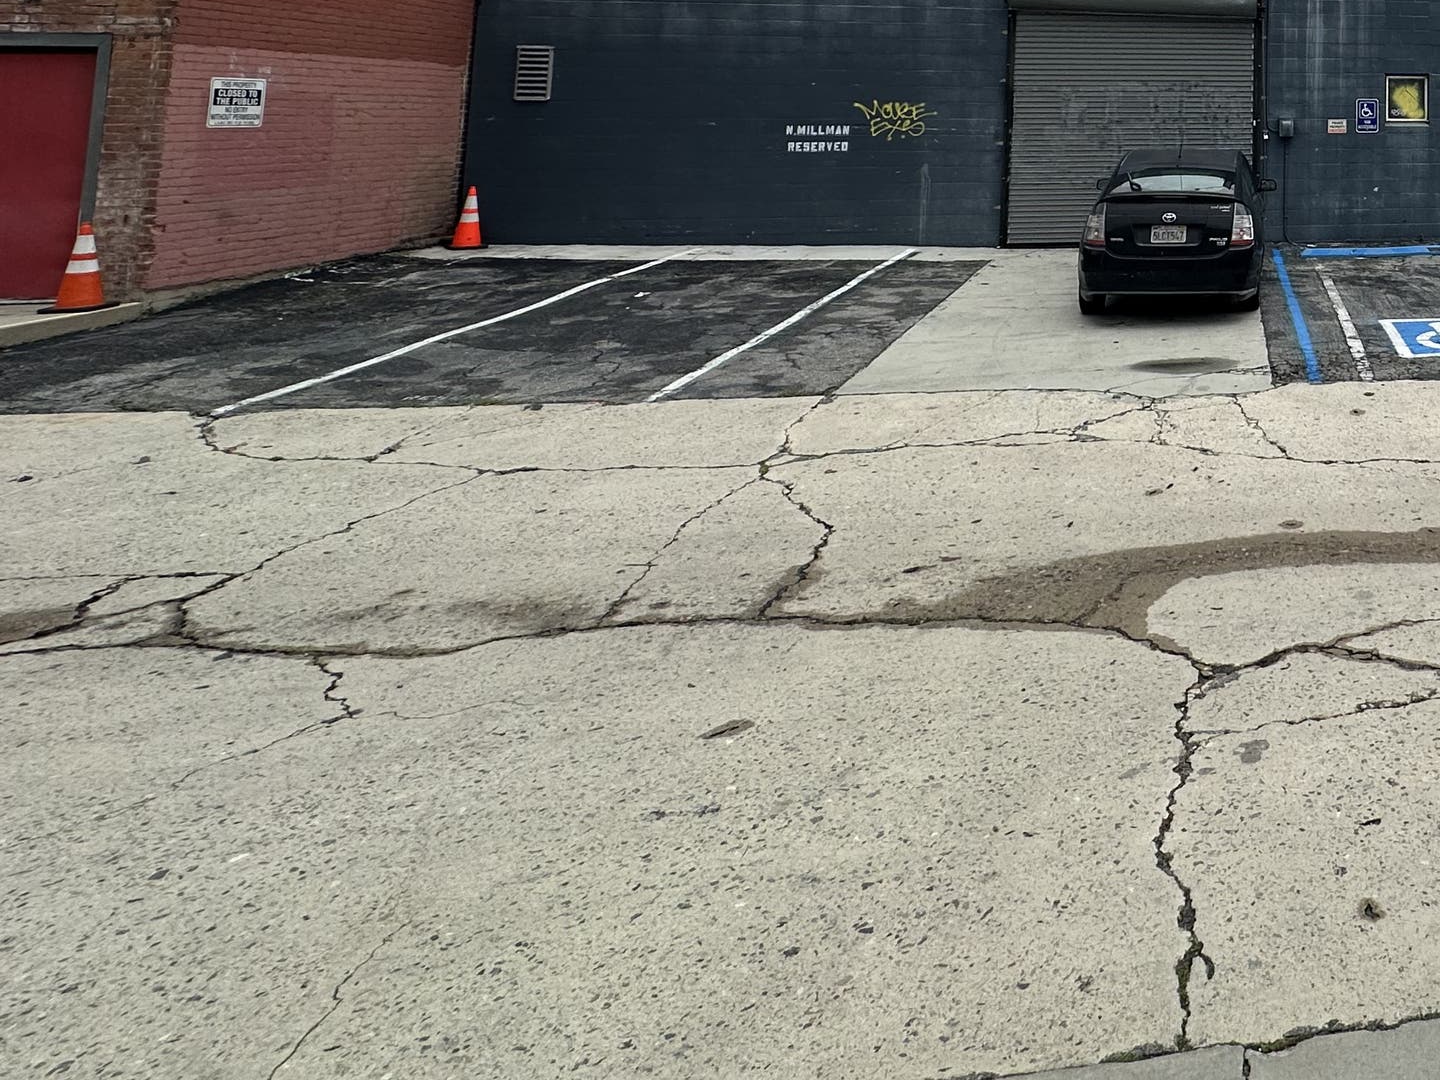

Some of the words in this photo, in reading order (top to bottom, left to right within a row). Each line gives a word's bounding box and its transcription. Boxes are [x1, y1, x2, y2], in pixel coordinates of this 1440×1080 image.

[218, 89, 247, 98] CLOSED
[248, 90, 258, 98] TO
[216, 97, 231, 105] THE
[232, 97, 259, 106] PUBLIC
[785, 125, 850, 136] N.MILLMAN
[787, 141, 849, 152] RESERVED
